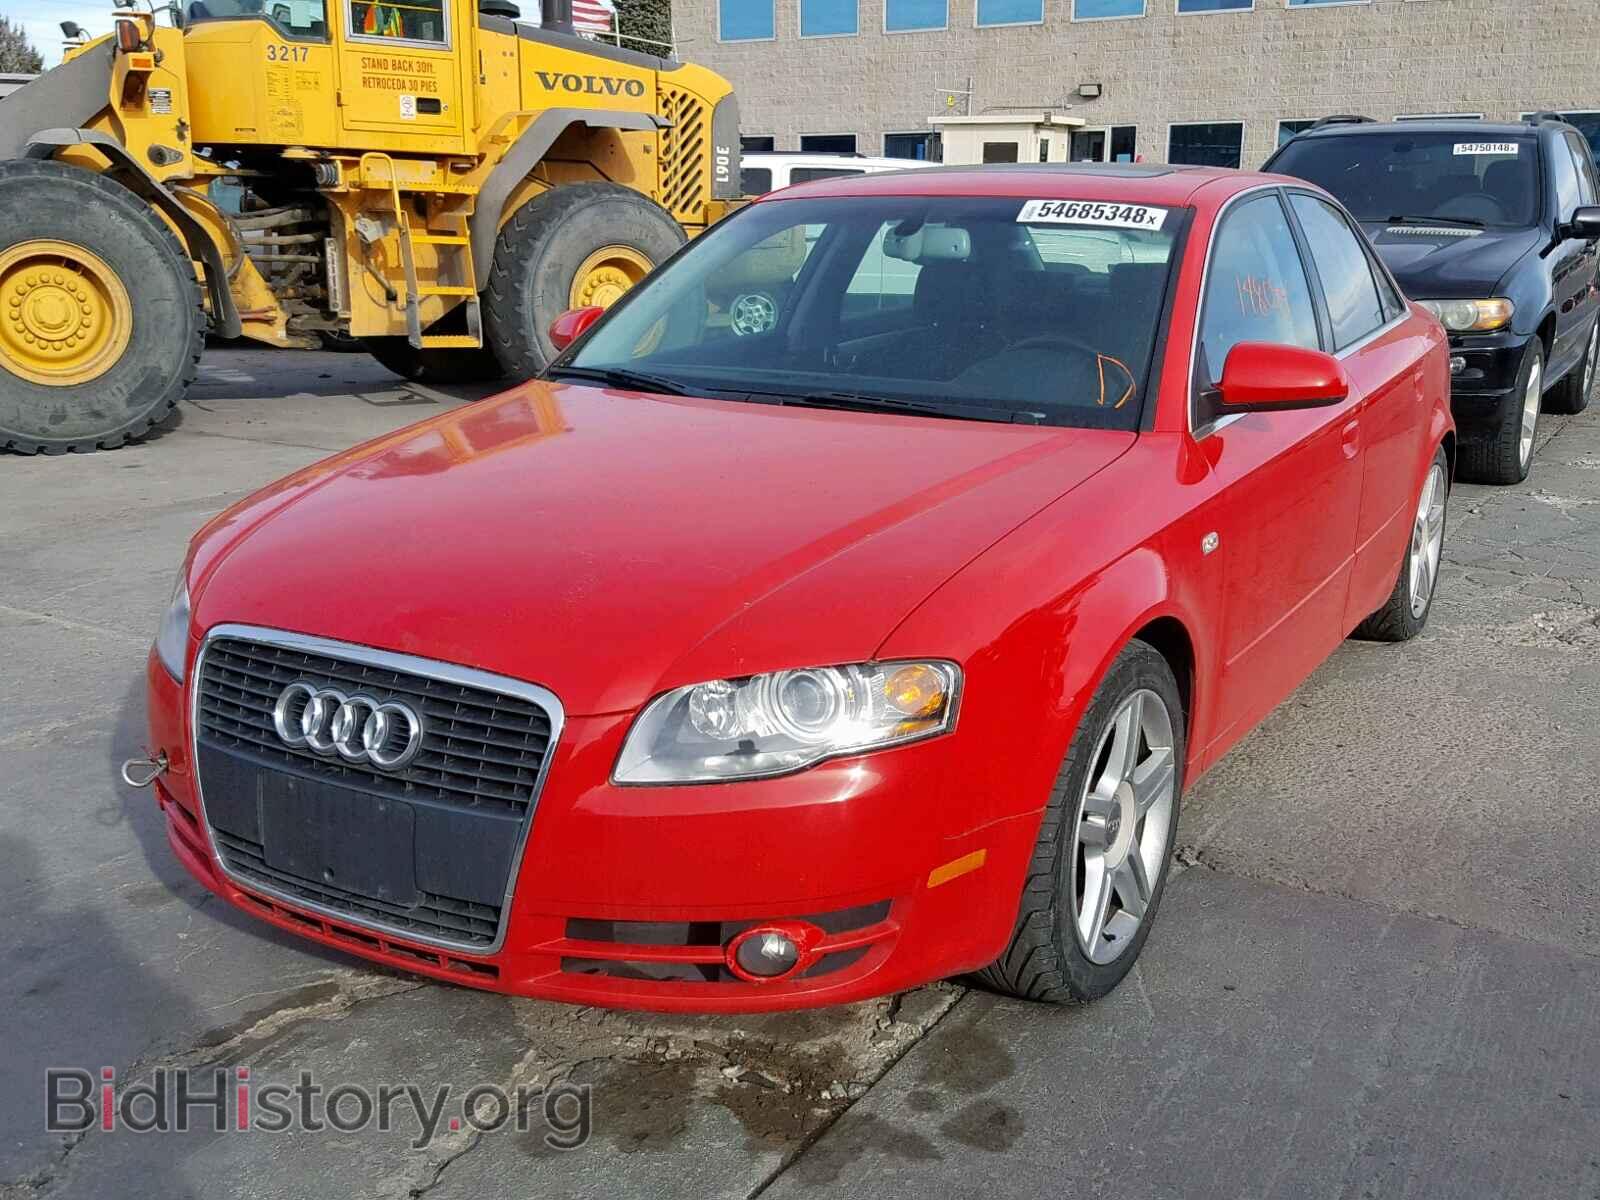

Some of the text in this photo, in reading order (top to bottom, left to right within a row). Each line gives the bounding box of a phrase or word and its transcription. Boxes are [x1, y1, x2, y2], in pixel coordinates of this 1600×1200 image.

[266, 44, 309, 62] 3217
[361, 57, 389, 70] STAND
[391, 59, 414, 72] BACK
[362, 76, 438, 92] RETROCEDA 30 PIES
[535, 71, 645, 96] VOLVO
[715, 145, 730, 183] L90E
[1096, 352, 1136, 409] D
